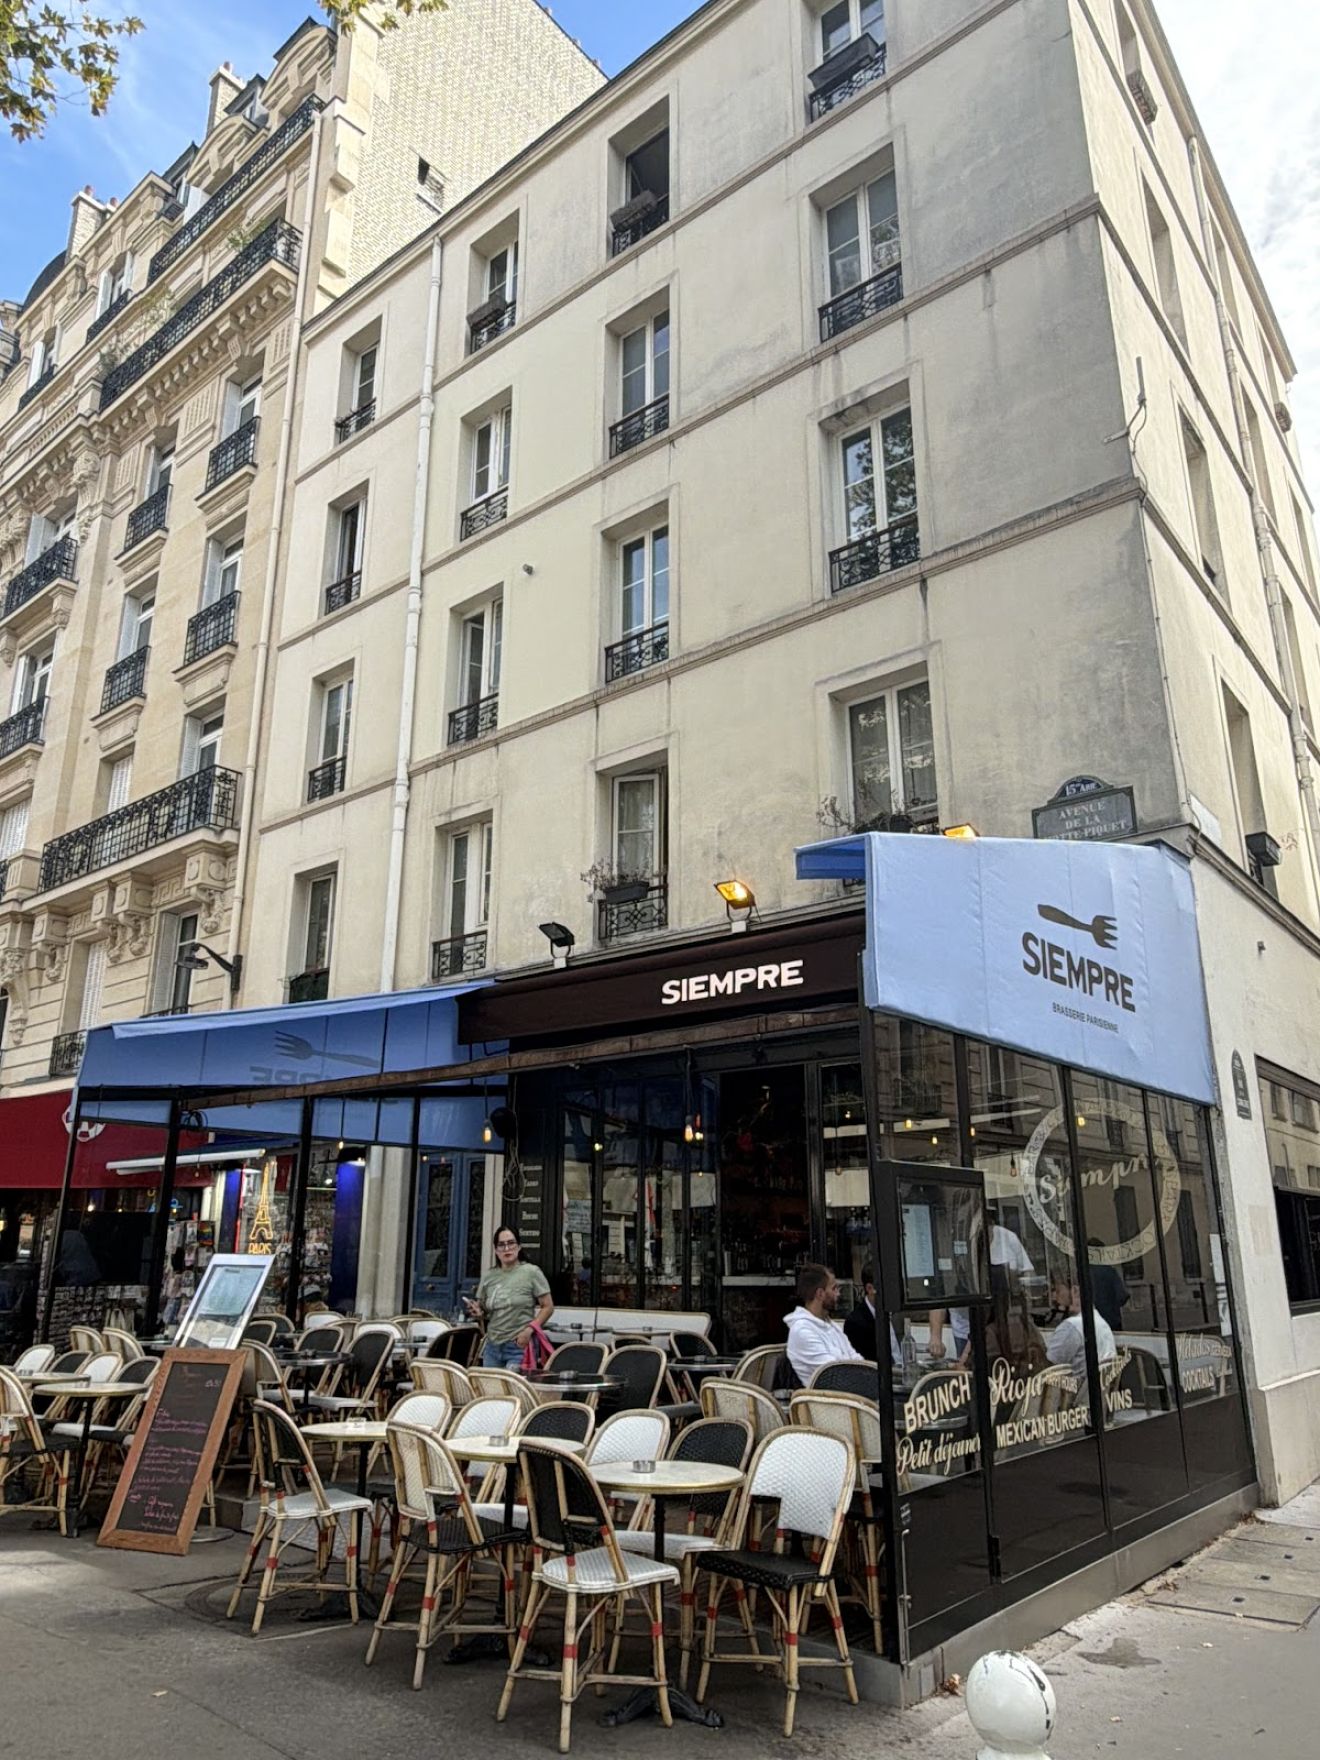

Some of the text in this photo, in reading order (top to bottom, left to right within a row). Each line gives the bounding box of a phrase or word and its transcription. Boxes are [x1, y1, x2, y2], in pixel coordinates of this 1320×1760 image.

[1059, 801, 1105, 819] AVENUE
[1065, 815, 1101, 830] DE LA
[661, 959, 804, 1005] SIEMPRE
[1022, 931, 1136, 1013] SIEMPRE
[1052, 1001, 1119, 1034] BRASSERIE PARISIENNE
[248, 1242, 272, 1254] PARIS
[1087, 1228, 1157, 1265] OCKTAILS
[988, 1357, 1045, 1417] Rioja
[1182, 1365, 1216, 1393] COCKTAILS
[904, 1373, 971, 1434] BRUNCH
[1105, 1388, 1132, 1413] VINS
[996, 1407, 1089, 1448] MEXICAN BURGER
[897, 1436, 932, 1475] Petit
